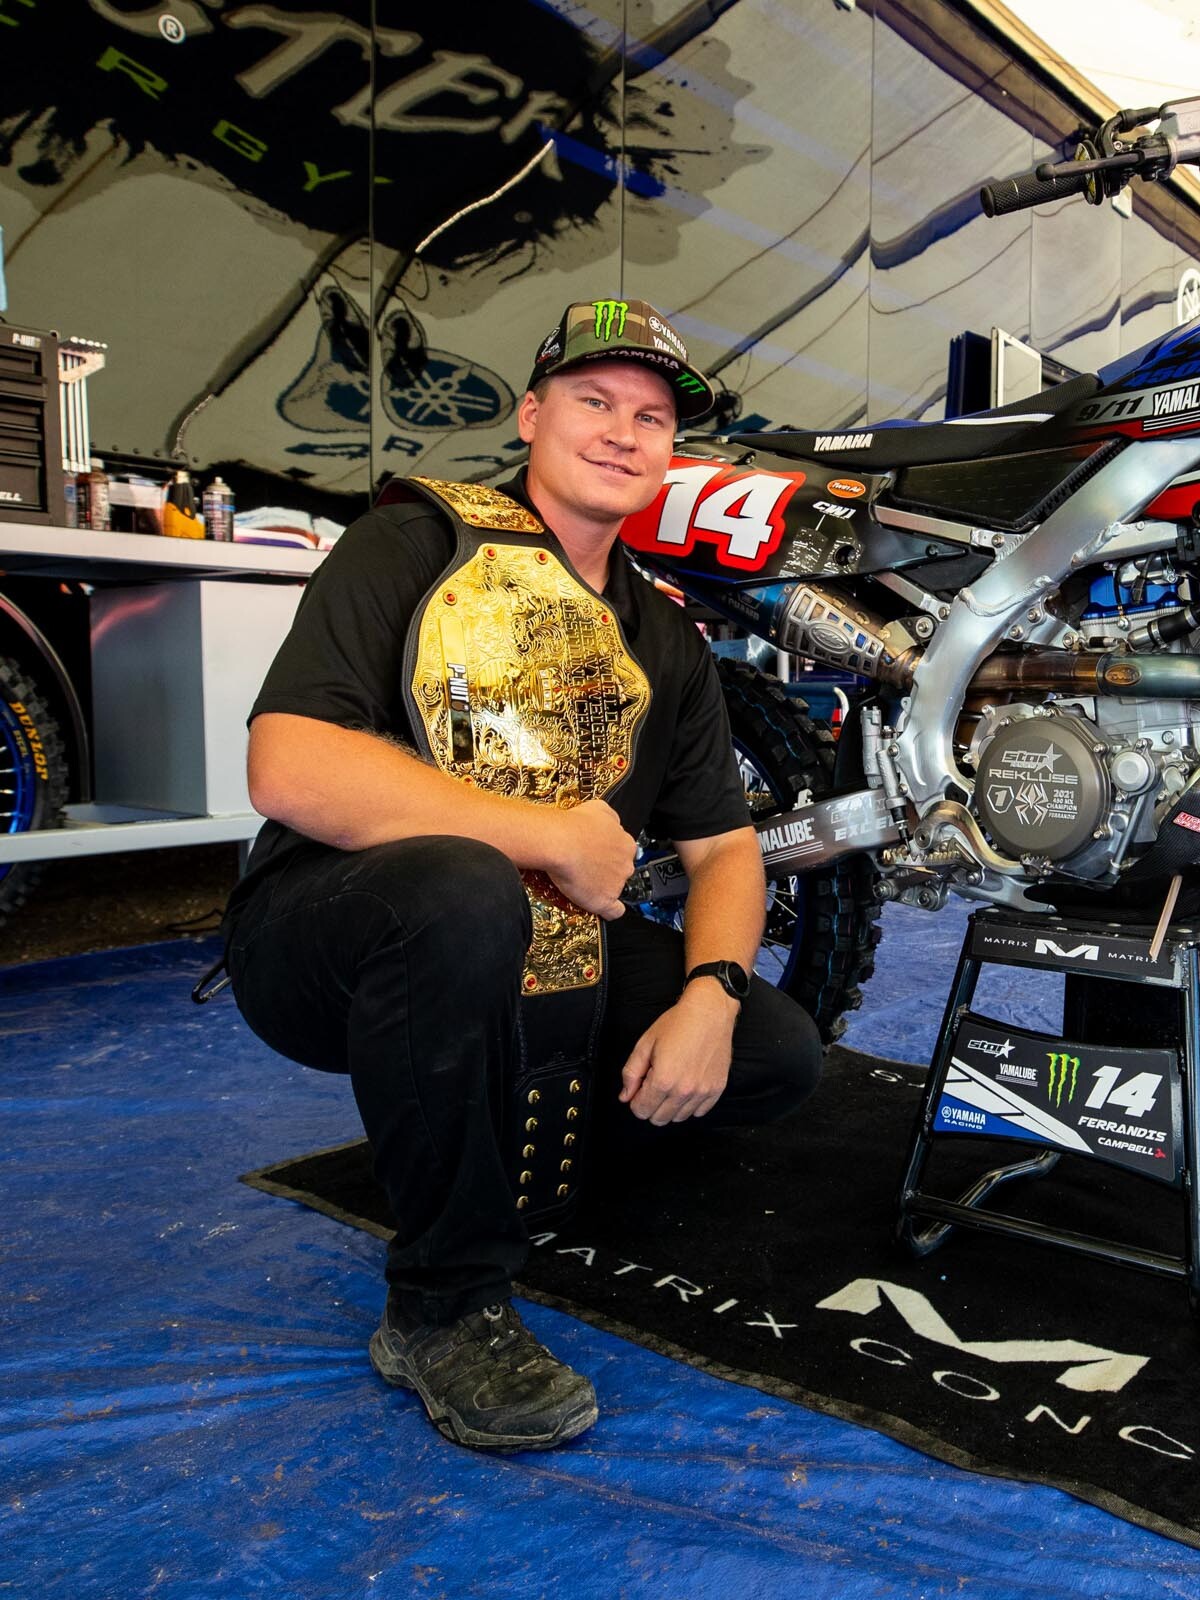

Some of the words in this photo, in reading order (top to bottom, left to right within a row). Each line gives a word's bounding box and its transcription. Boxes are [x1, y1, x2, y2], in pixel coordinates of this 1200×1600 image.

[1075, 396, 1145, 422] 9/11
[813, 433, 874, 451] YAMAHA
[656, 465, 796, 560] 14
[447, 663, 469, 703] P-NUT
[9, 702, 49, 780] DUNLOP
[988, 768, 1079, 785] REKLUSE
[994, 789, 1008, 807] 1
[1053, 789, 1075, 799] 2021
[1046, 803, 1078, 811] CHAMPION
[1048, 812, 1076, 820] FERRANDIS
[984, 936, 1029, 948] MATRIX
[1108, 952, 1158, 964] MATRIX
[1000, 1063, 1037, 1081] YAMALUBE
[1084, 1065, 1163, 1118] 14
[943, 1118, 983, 1130] RACING
[951, 1107, 986, 1126] YAMAHA
[1077, 1115, 1168, 1143] FERRANDIS
[1097, 1137, 1155, 1156] CAMPBELL
